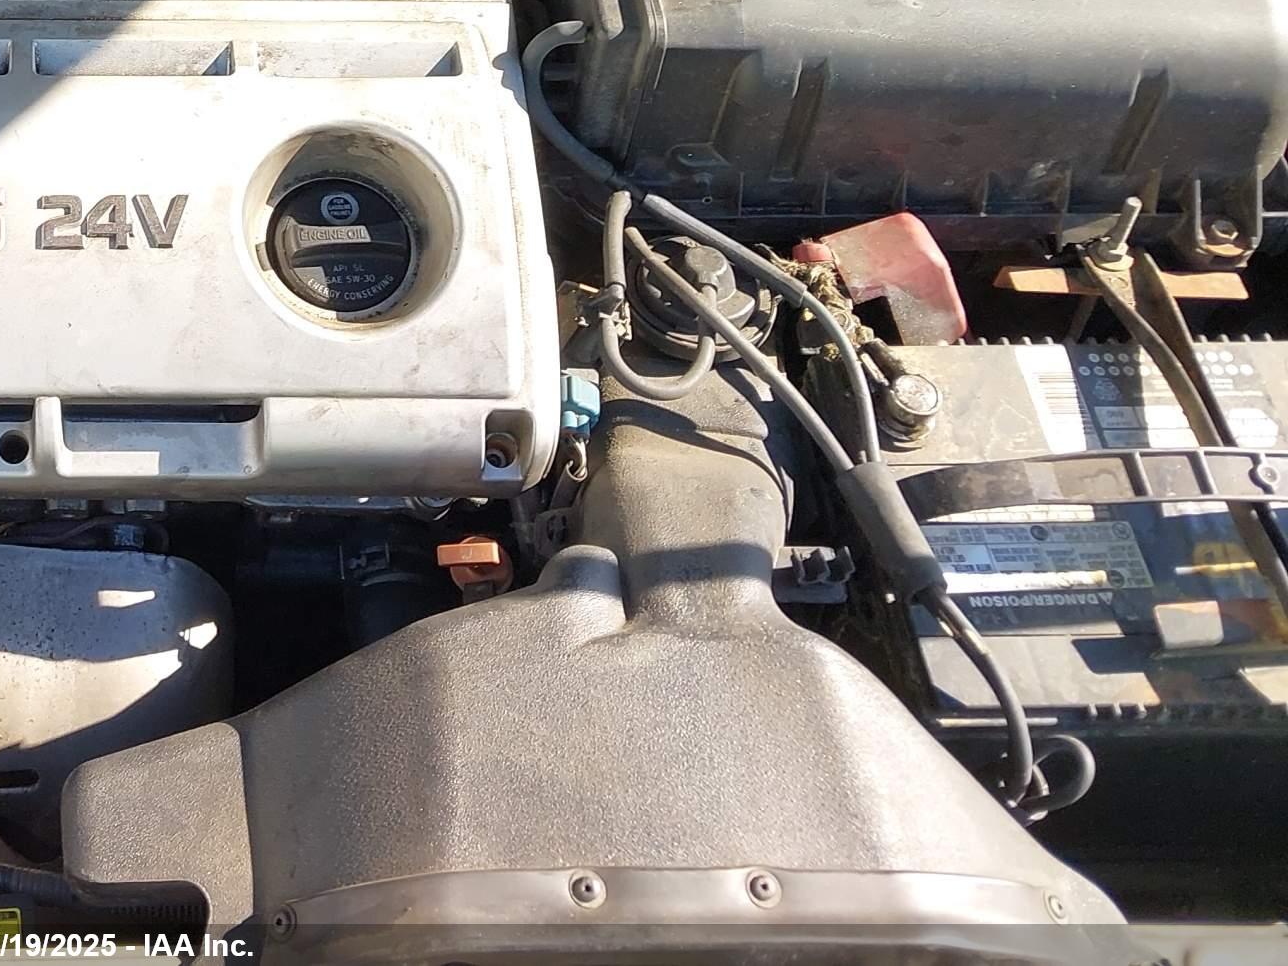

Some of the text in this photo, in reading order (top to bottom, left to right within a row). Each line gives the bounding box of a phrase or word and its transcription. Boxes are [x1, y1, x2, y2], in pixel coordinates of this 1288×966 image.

[35, 194, 189, 250] 24V
[299, 228, 367, 242] ENGINE OIL
[325, 274, 376, 284] SAE 5W-30
[307, 274, 395, 300] ENERGY CONSERVING
[969, 594, 1099, 609] DANGER/POISON
